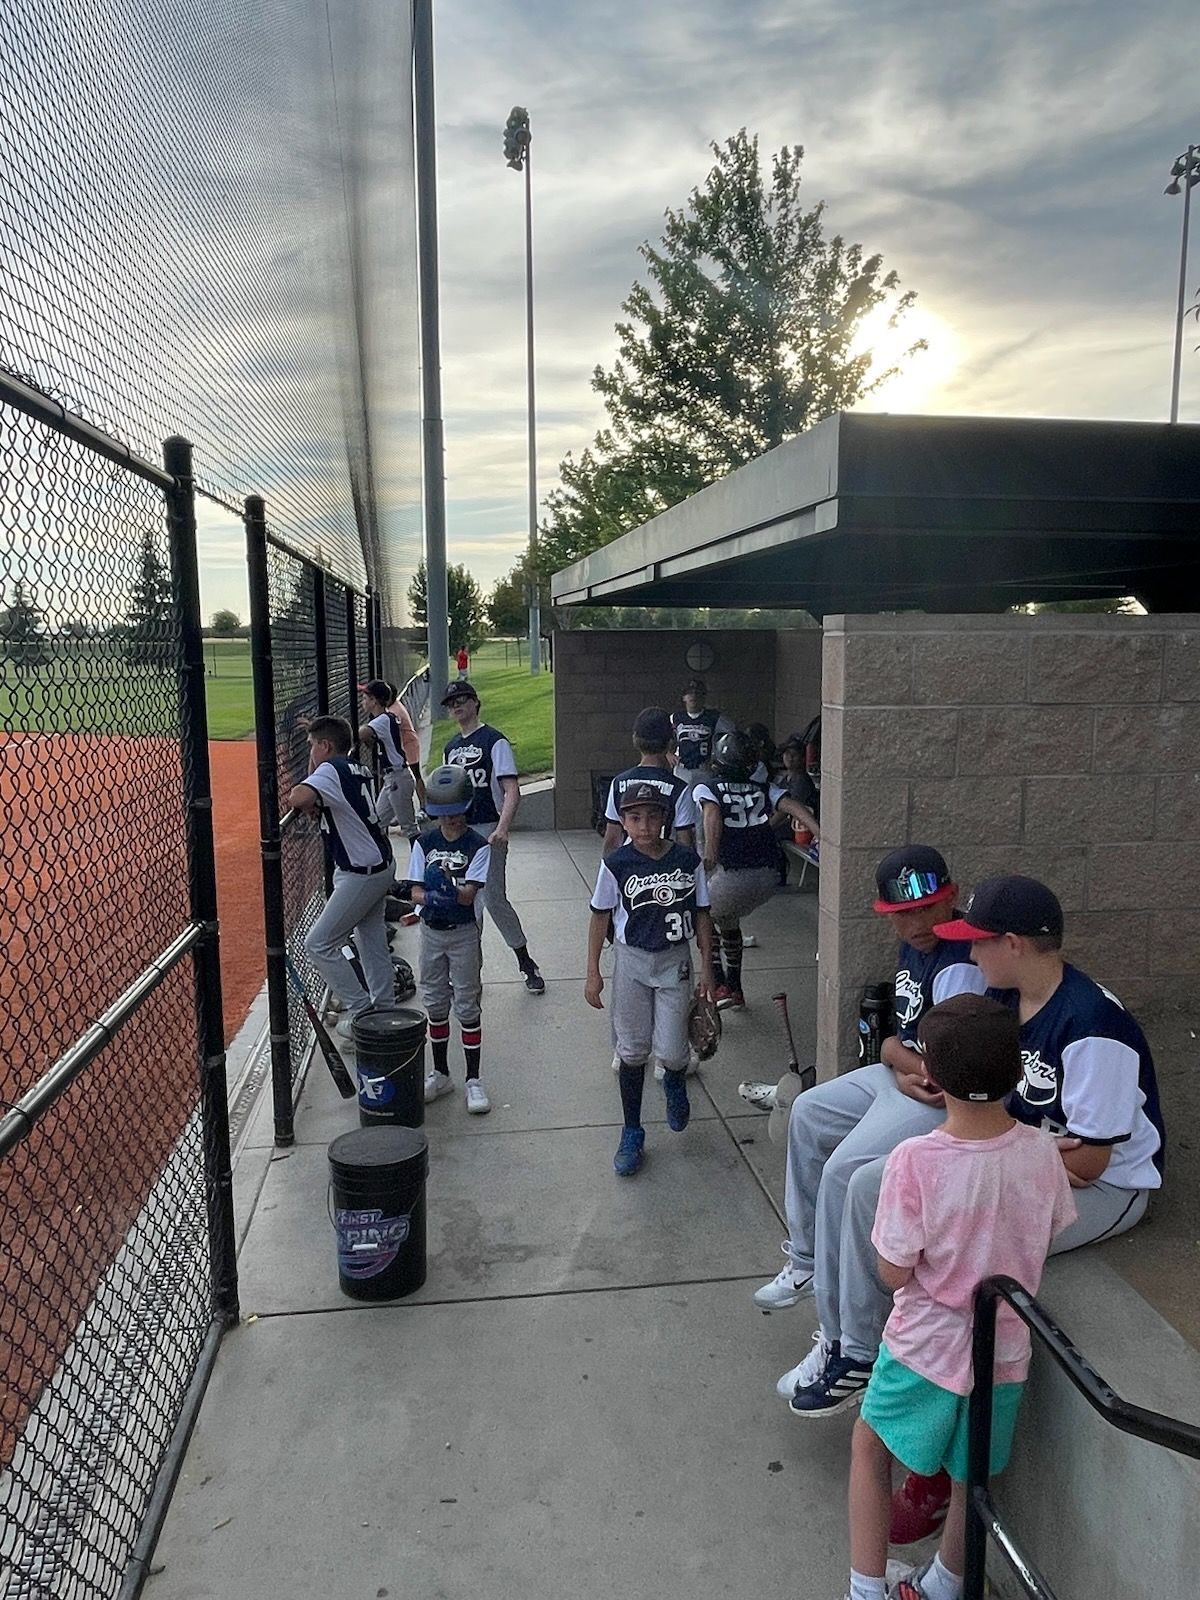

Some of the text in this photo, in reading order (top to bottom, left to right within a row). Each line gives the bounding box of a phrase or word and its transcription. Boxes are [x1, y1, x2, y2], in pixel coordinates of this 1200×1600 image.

[467, 768, 489, 788] 12
[722, 791, 769, 828] 32
[624, 868, 696, 899] Crusaders
[664, 910, 695, 942] 30
